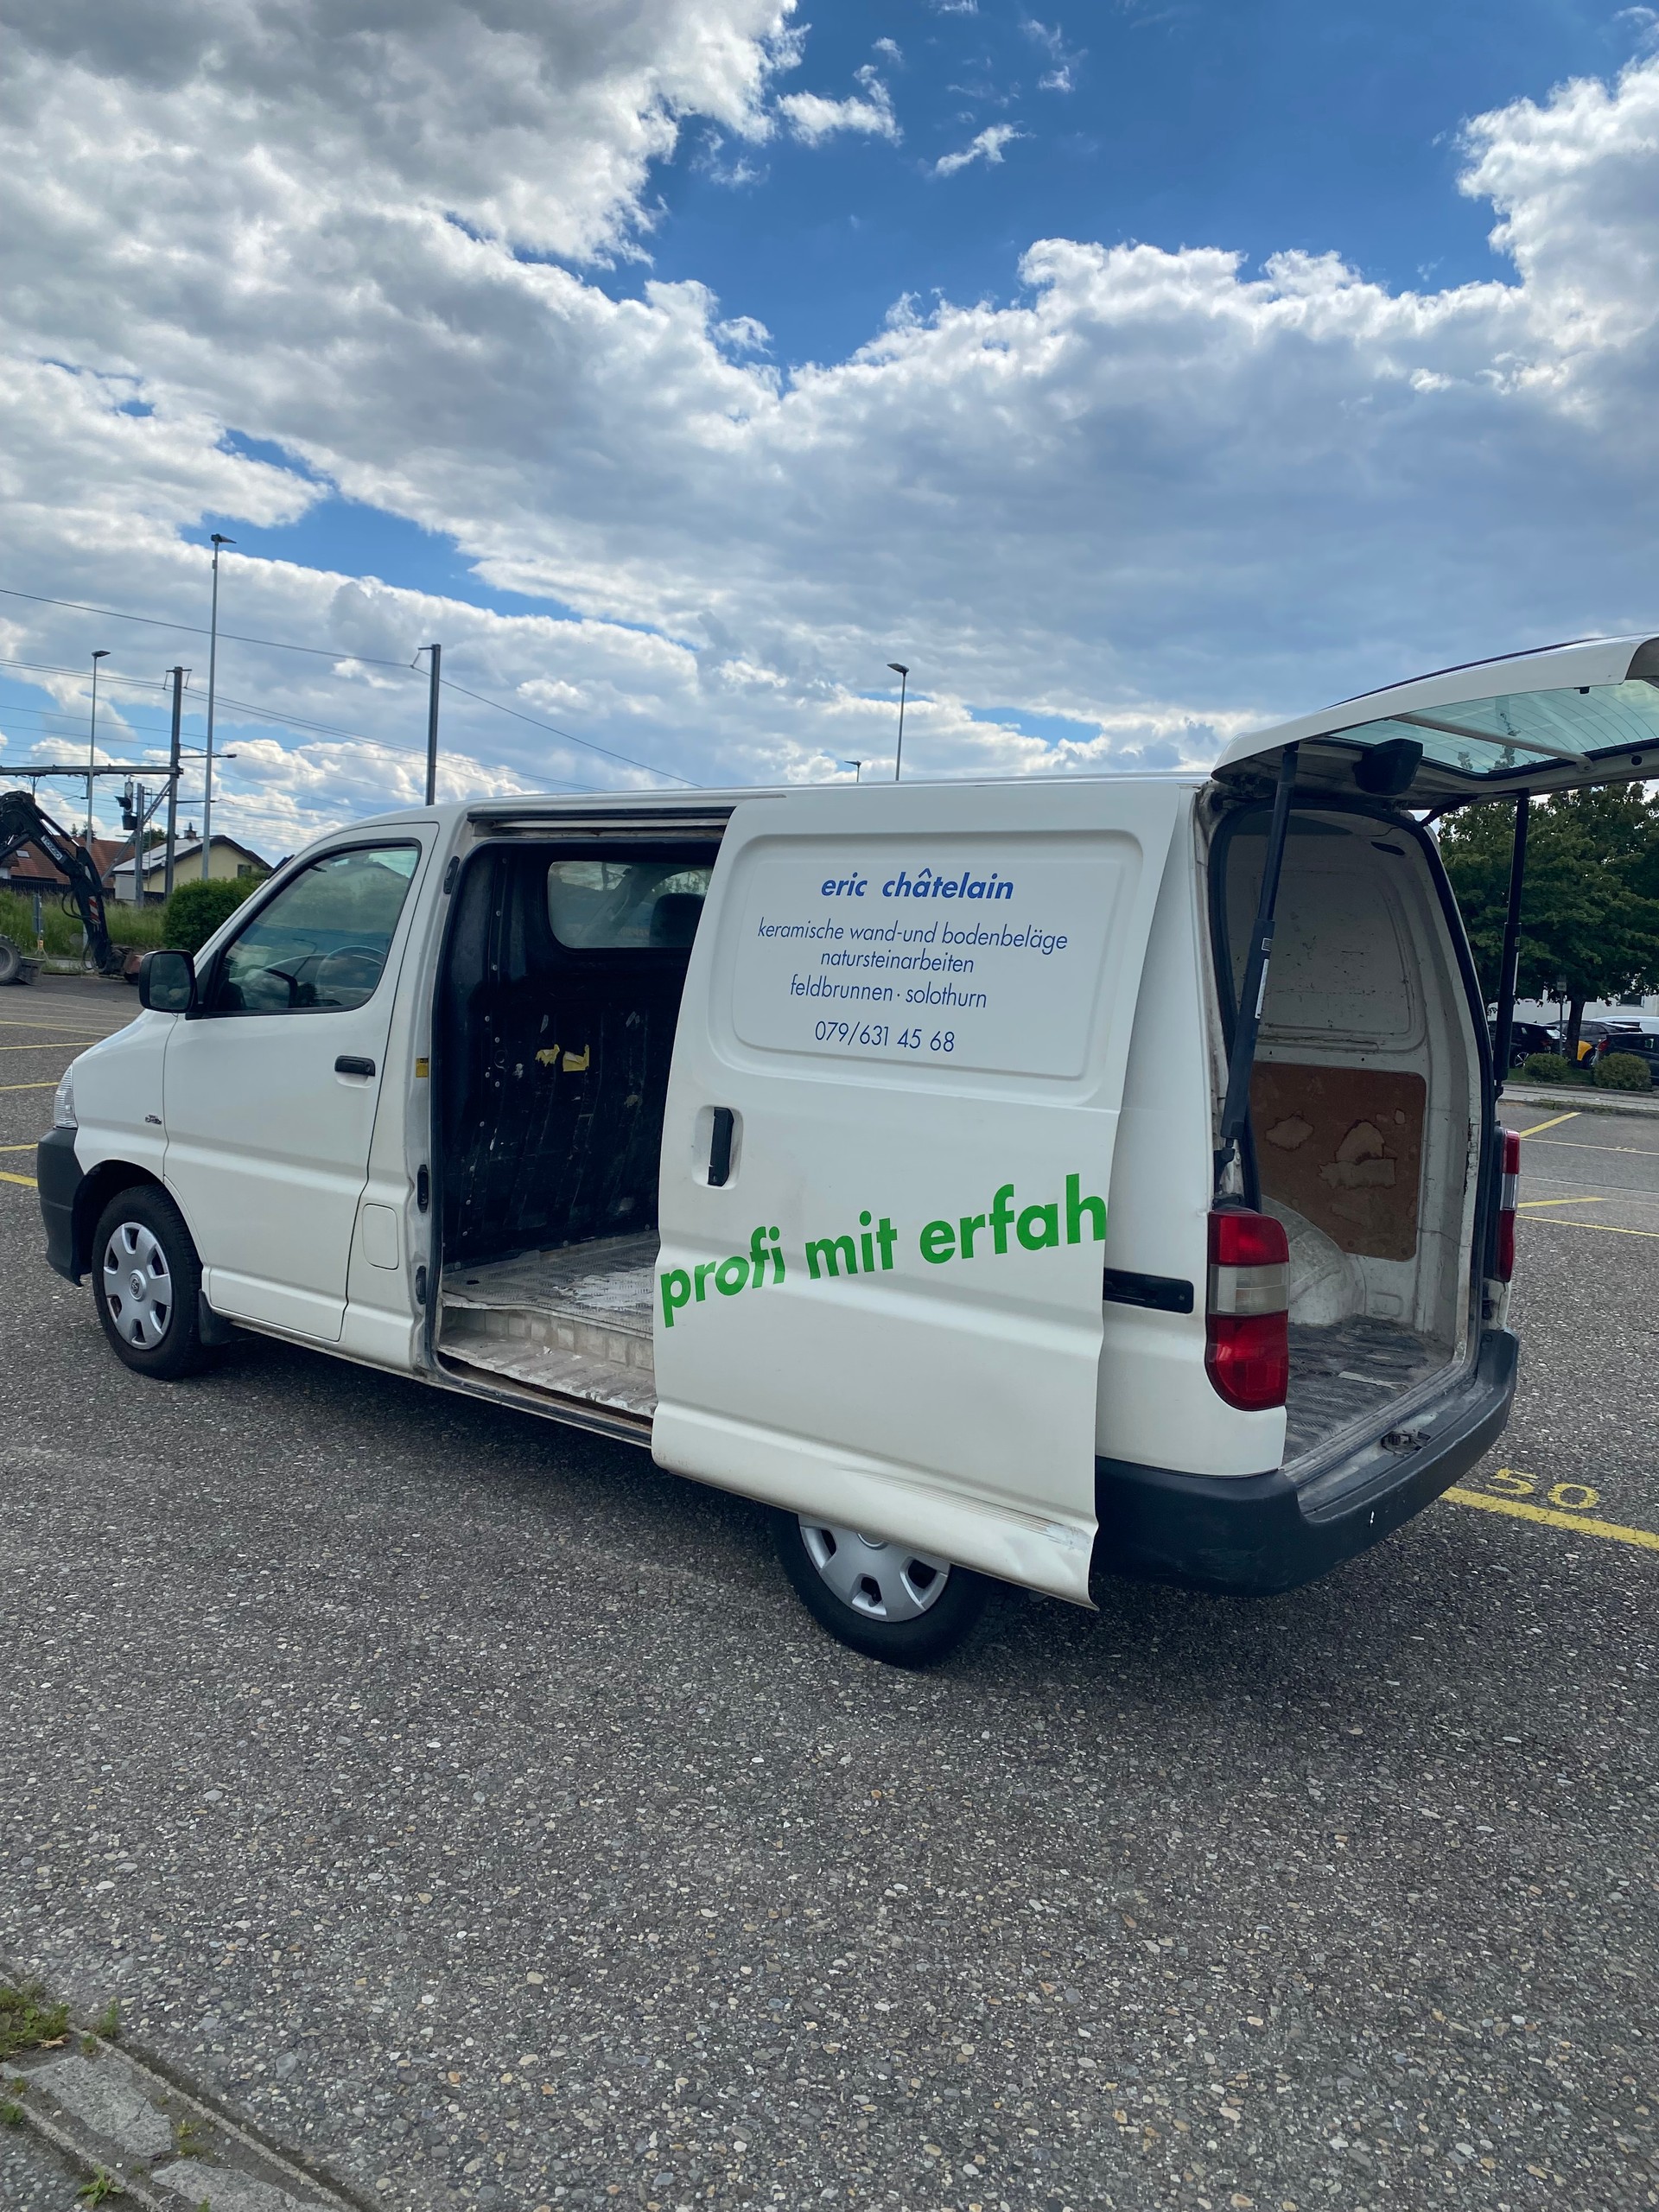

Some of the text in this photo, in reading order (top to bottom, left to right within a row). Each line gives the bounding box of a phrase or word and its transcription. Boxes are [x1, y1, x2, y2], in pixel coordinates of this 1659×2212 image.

[820, 868, 1014, 899] eric châtelain
[757, 916, 845, 940] keramische
[941, 921, 1068, 956] bodenbeläge
[820, 948, 975, 973] natursteinarbeiten
[790, 973, 893, 1002] feldbrunnen
[905, 981, 988, 1008] solothurn
[815, 1020, 955, 1052] 079/631 45 68
[659, 1173, 1107, 1328] profi mit erfah
[1485, 1467, 1599, 1509] 50
